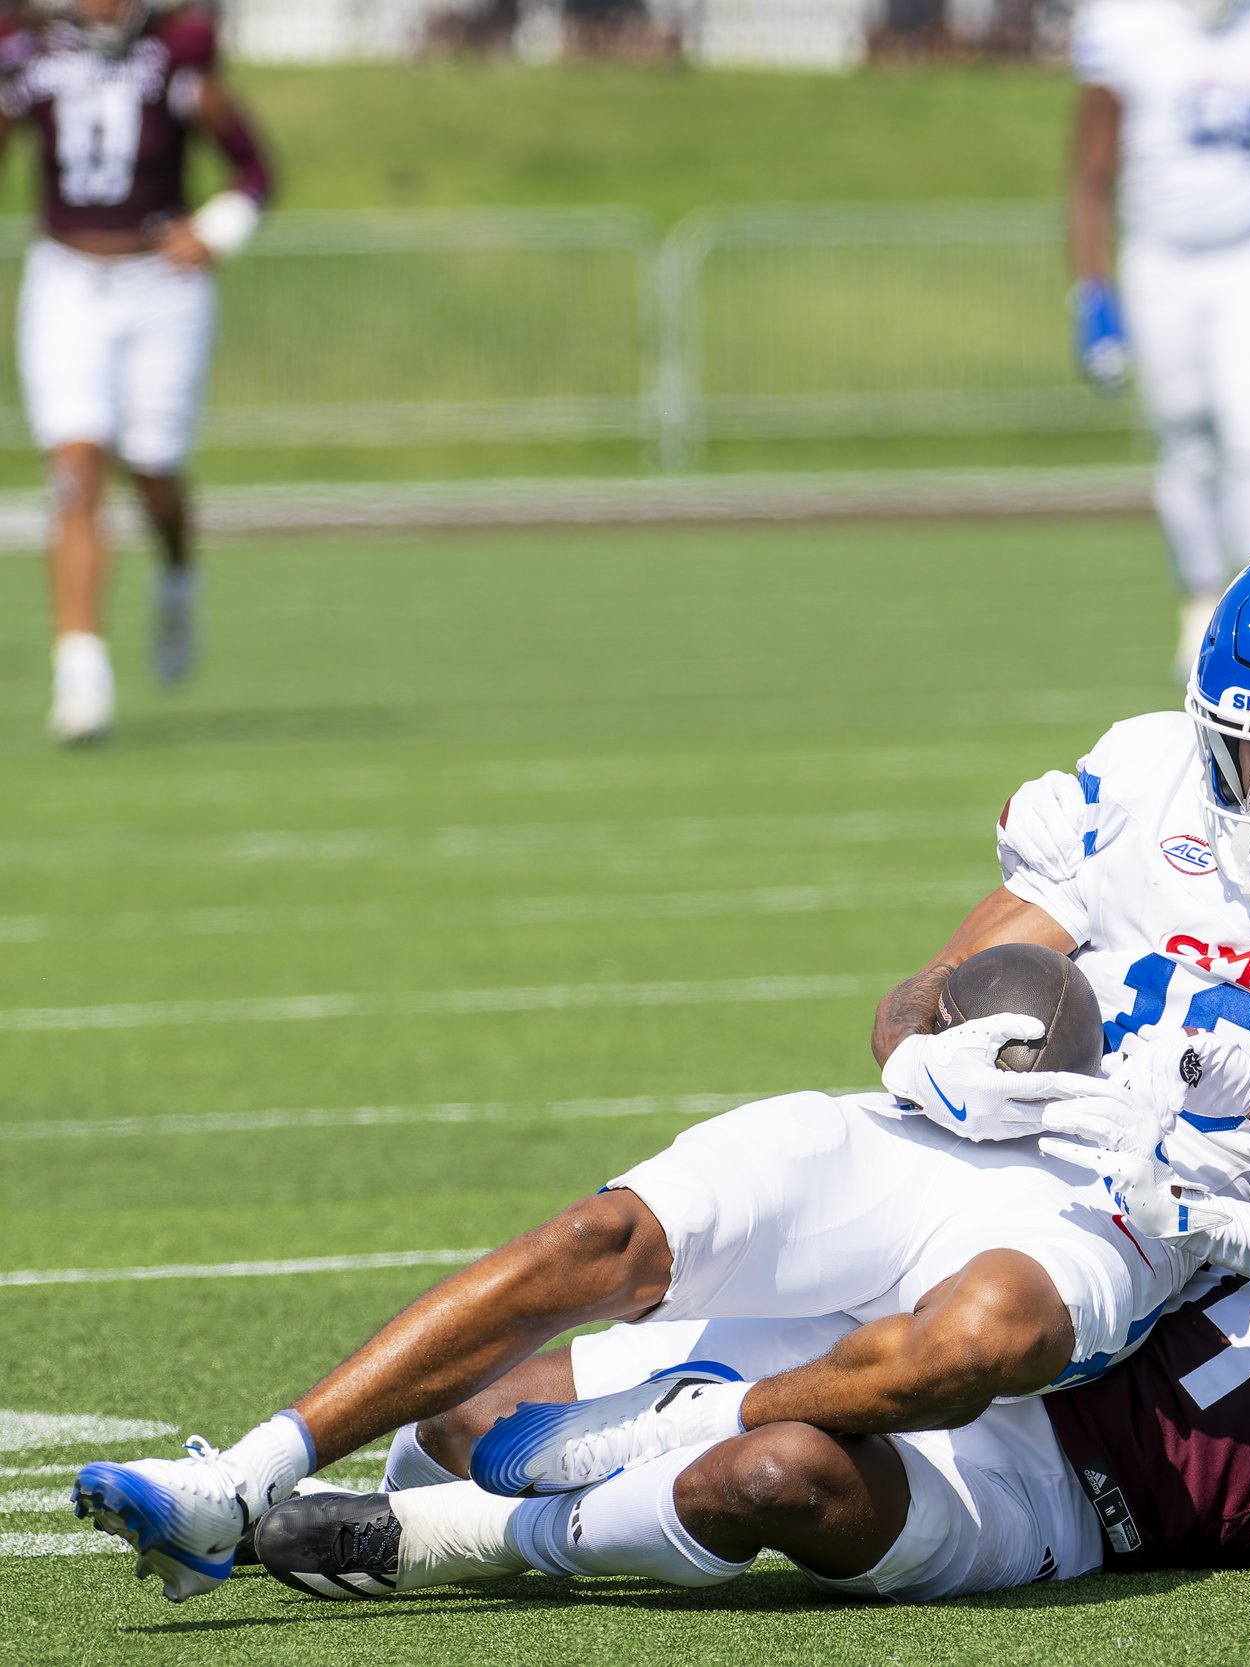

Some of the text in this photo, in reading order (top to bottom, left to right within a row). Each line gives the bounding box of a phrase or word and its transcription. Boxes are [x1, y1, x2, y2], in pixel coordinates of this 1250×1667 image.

[1168, 843, 1213, 865] ACC
[1083, 1469, 1101, 1495] adidas
[1104, 1505, 1116, 1517] M
